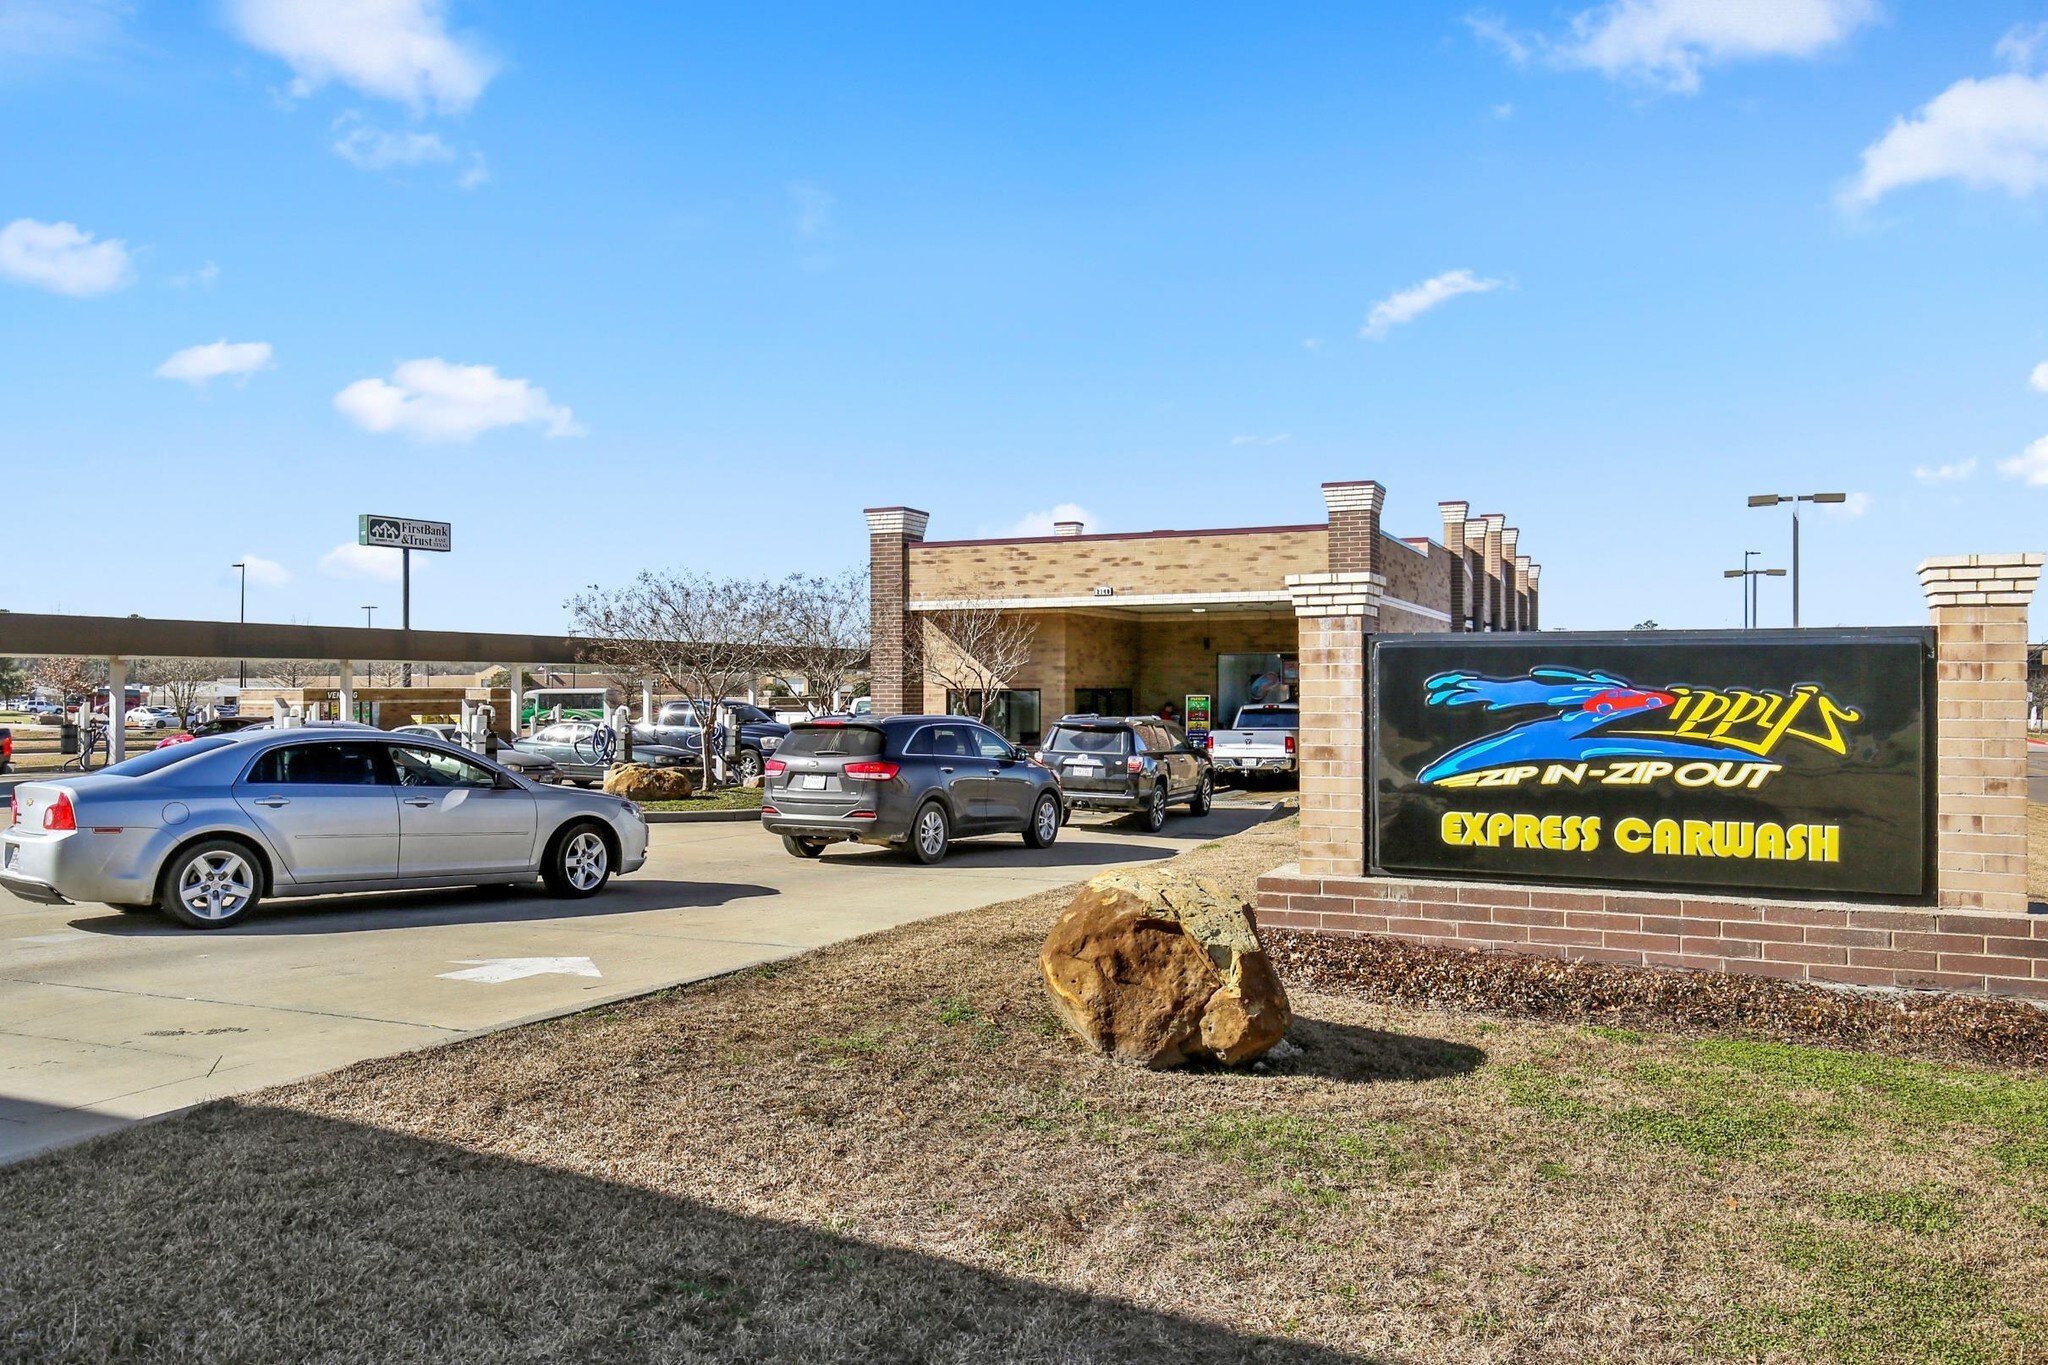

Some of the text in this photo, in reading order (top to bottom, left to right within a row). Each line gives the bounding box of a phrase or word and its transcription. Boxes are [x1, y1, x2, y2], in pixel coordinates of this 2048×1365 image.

[401, 521, 448, 537] FirstBank
[327, 691, 358, 699] VENG
[1475, 765, 1539, 787] ZIP
[1674, 761, 1783, 789] OUT
[1440, 810, 1840, 863] EXPRESS CARWASH
